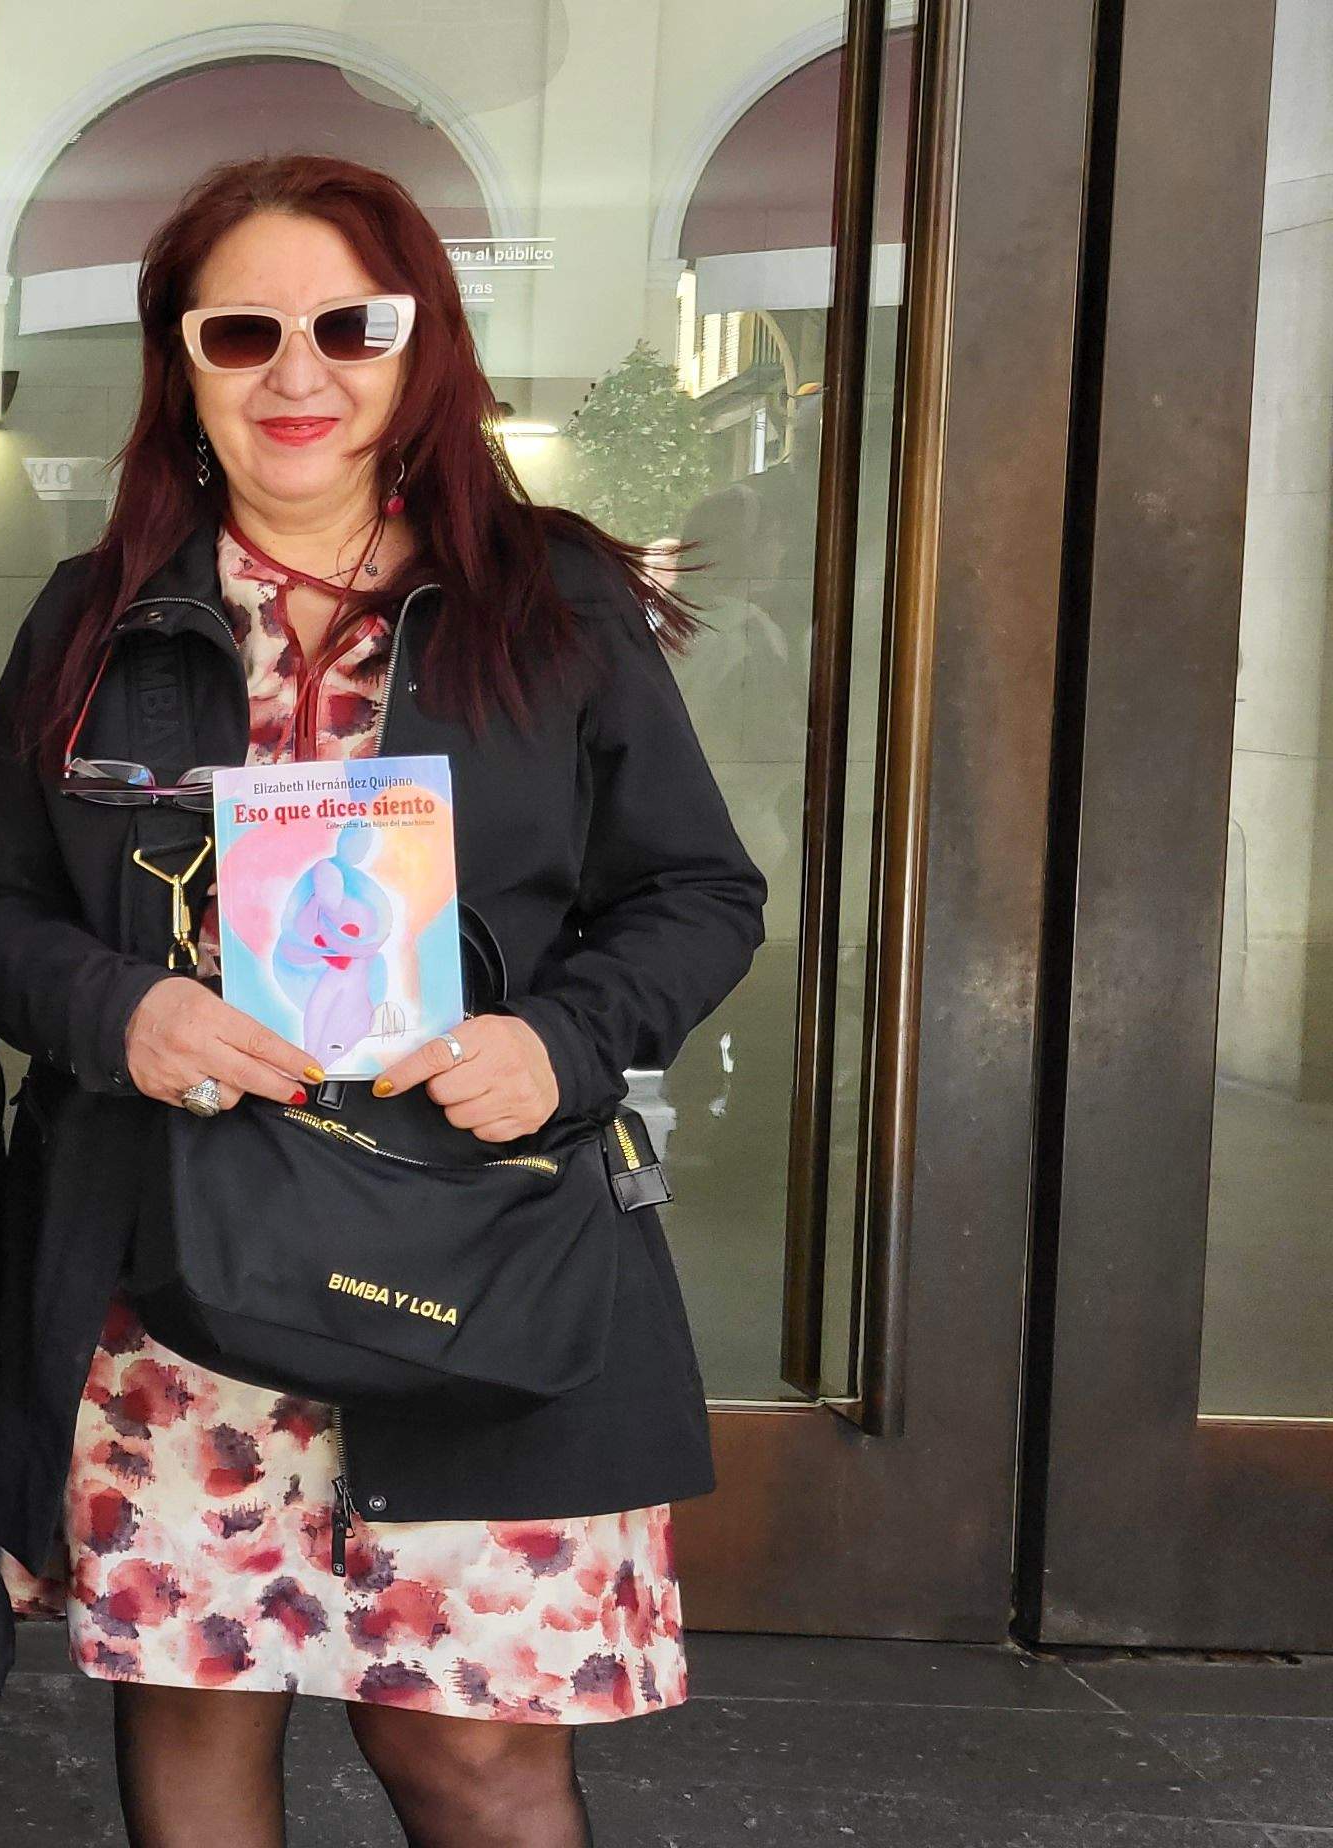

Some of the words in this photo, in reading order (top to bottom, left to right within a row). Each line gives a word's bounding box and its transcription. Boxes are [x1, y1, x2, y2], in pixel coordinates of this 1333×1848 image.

[475, 247, 490, 260] al
[494, 246, 554, 264] público
[253, 779, 304, 795] Elizabeth
[307, 776, 367, 792] Hernández
[369, 775, 413, 791] Quijano
[234, 803, 269, 824] Eso
[274, 804, 312, 825] que
[317, 798, 367, 818] dices
[372, 796, 436, 816] siento
[328, 1272, 390, 1306] BIMBA
[394, 1291, 409, 1309] Y
[409, 1297, 457, 1326] LOLA
